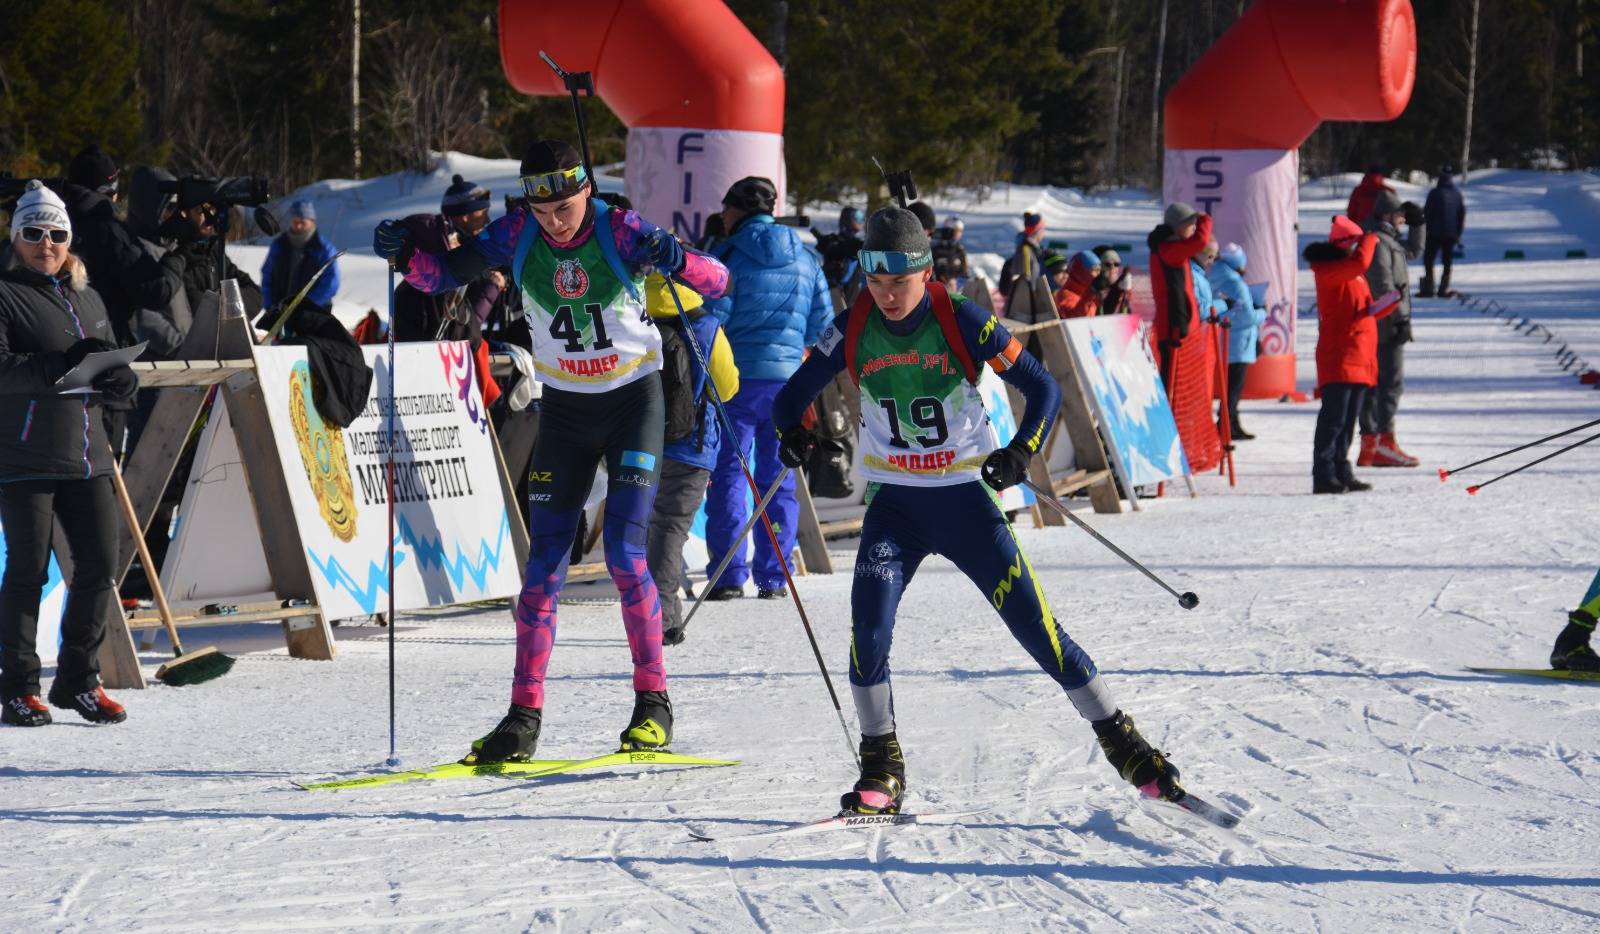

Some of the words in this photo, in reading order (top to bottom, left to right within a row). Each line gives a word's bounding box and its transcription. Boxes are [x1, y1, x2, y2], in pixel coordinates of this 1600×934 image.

[549, 303, 614, 353] 41
[557, 353, 619, 377] РИДДЕР
[392, 393, 456, 417] ЕСПУБЛИКАСЫ
[879, 396, 949, 448] 19
[431, 425, 462, 451] СПОРТ
[631, 753, 656, 761] FISCHER
